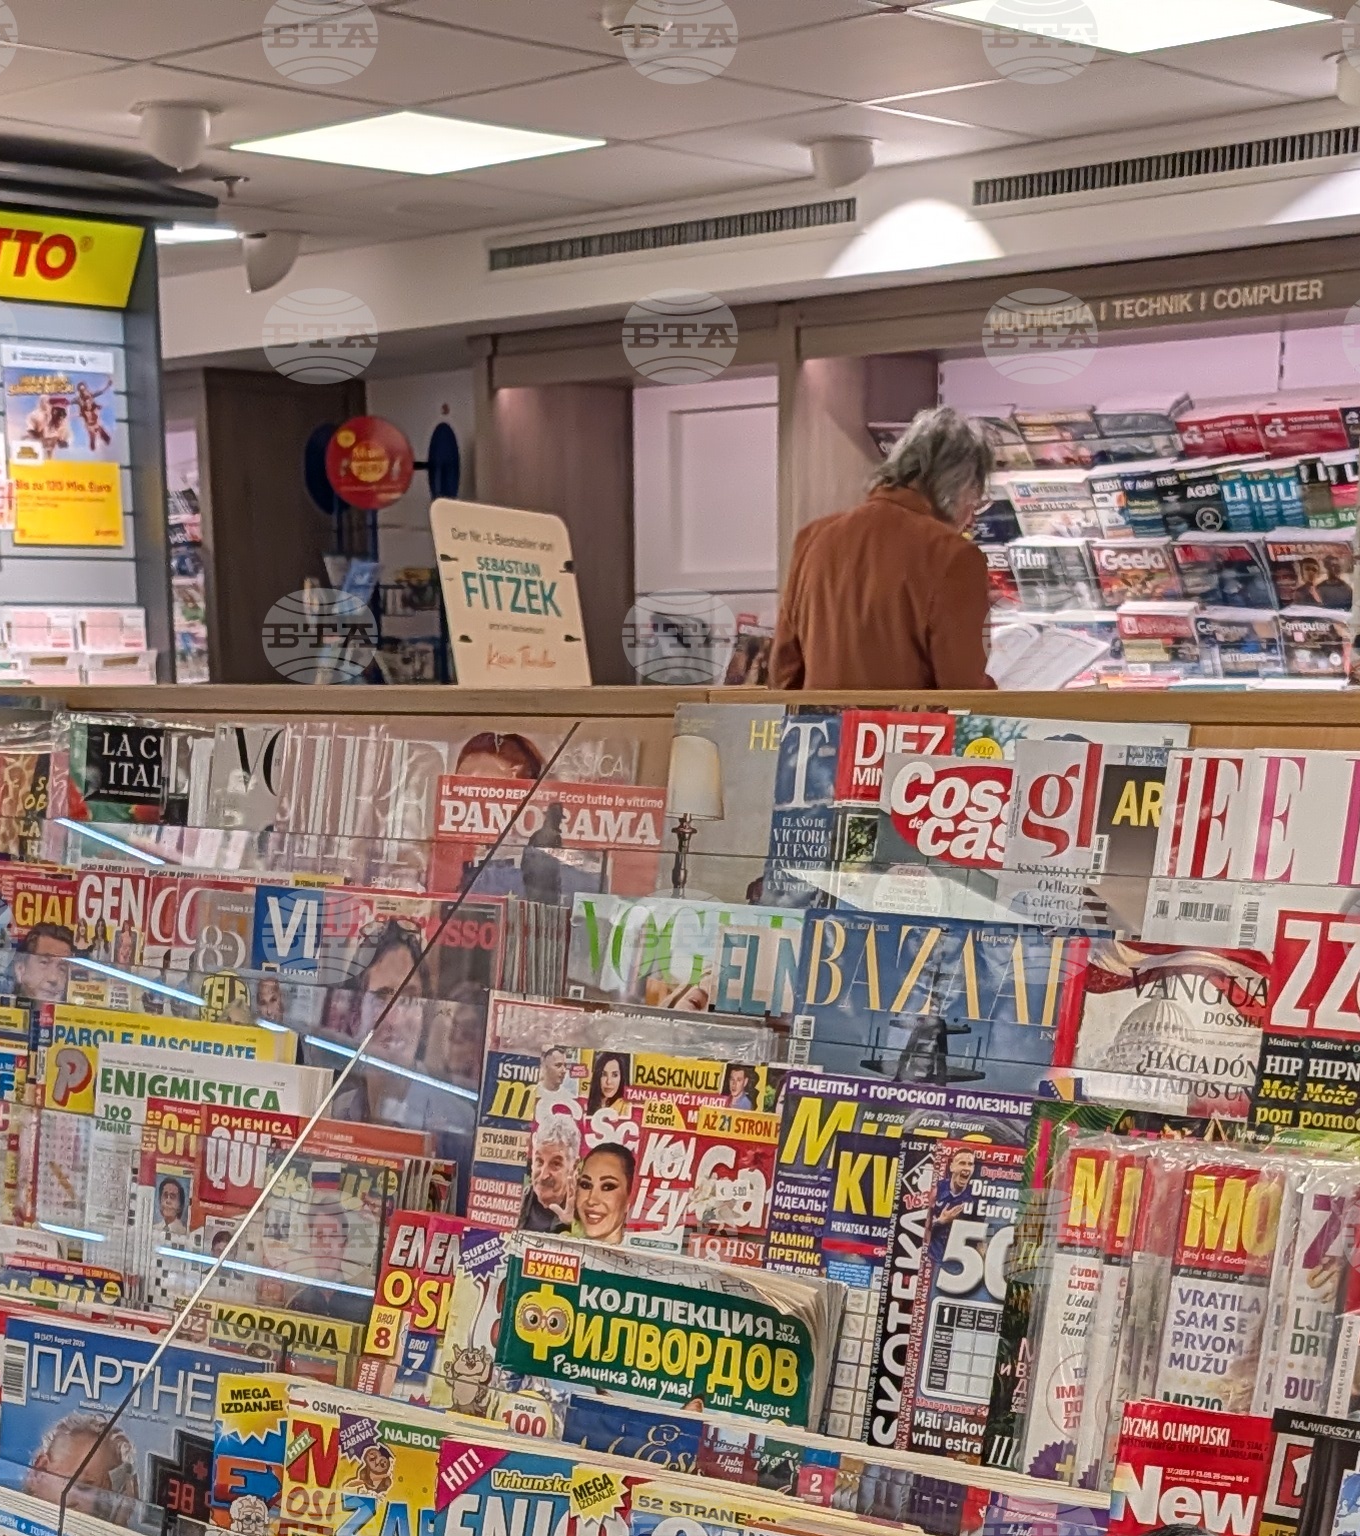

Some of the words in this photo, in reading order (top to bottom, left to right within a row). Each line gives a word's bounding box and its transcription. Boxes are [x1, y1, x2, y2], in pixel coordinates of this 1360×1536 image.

[990, 308, 1092, 332] MULTIMEDIA
[1114, 292, 1192, 321] TECHNIK
[1214, 279, 1324, 308] COMPUTER
[477, 557, 542, 577] SEBASTIAN
[462, 572, 562, 617] FITZEK
[102, 732, 134, 757] LA
[635, 1065, 721, 1089] RASKINULI
[1264, 1054, 1303, 1077] HIP
[101, 1069, 281, 1111] ENIGMISTICA
[790, 1076, 858, 1097] РЕЦЕПТЫ
[870, 1085, 945, 1106] ГОРОСКОП
[956, 1095, 1032, 1115] ПОЛЕЗНЫЕ
[104, 1104, 132, 1121] 100
[211, 1112, 293, 1136] DOMENICA
[877, 1113, 904, 1124] 8/2026
[942, 1119, 985, 1132] женщин
[770, 1232, 814, 1249] КАМНИ
[831, 1221, 869, 1236] HRVATSKA
[462, 1237, 500, 1262] SUPER
[528, 1251, 578, 1269] КРУПНАЯ
[527, 1262, 575, 1282] БУКВА
[579, 1284, 774, 1341] КОЛЛЕКЦИЯ
[1177, 1289, 1261, 1315] VRATILA
[213, 1307, 339, 1352] KORONA
[1175, 1310, 1217, 1332] SAM
[1221, 1316, 1247, 1335] SE
[373, 1328, 391, 1350] 8
[514, 1284, 800, 1399] ФИЛВОРДОВ
[1171, 1332, 1243, 1357] PRVOM
[553, 1353, 630, 1389] Разминка
[630, 1372, 659, 1397] для
[660, 1377, 694, 1399] ума!
[1168, 1351, 1228, 1376] MUŽU
[230, 1386, 271, 1401] MEGA
[221, 1397, 283, 1416] IZDANJE!
[710, 1393, 733, 1409] Juli
[743, 1398, 791, 1420] August
[502, 1409, 547, 1438] 100
[1162, 1423, 1230, 1448] OLIMPIJSKI
[441, 1449, 485, 1491] HIT!
[1114, 1462, 1258, 1536] New
